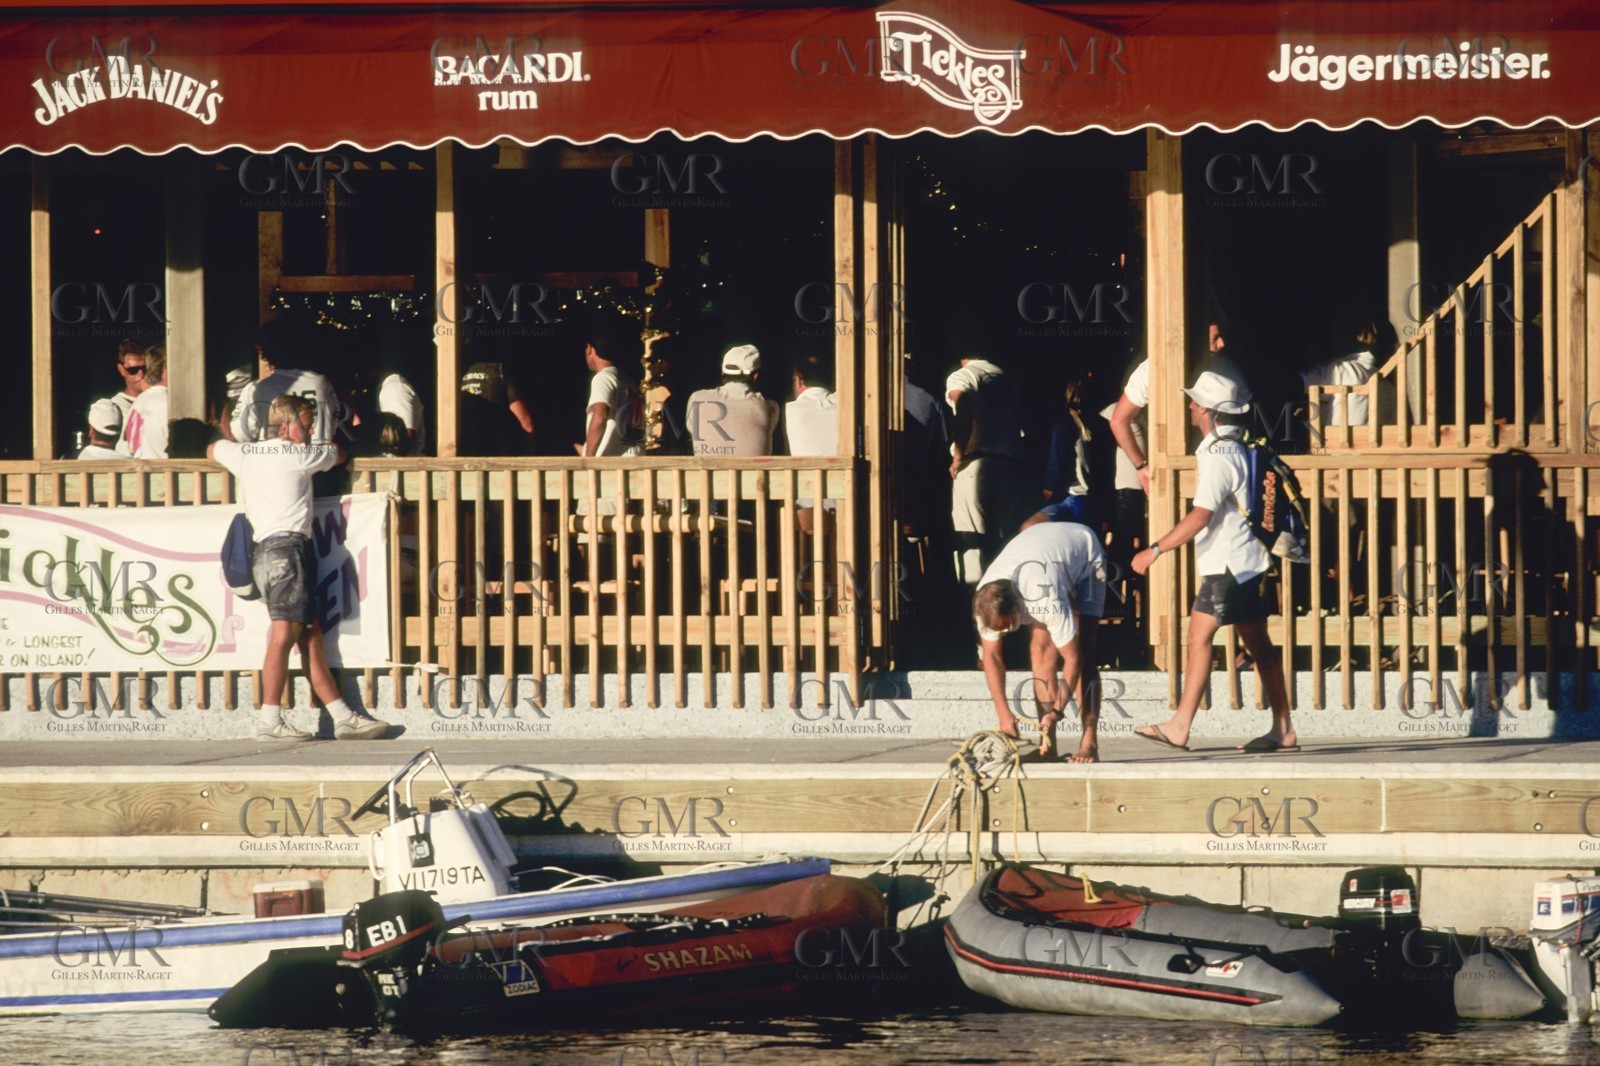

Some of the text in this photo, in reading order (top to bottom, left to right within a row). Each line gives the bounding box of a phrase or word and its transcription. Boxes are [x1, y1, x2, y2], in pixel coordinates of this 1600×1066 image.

[889, 31, 1012, 125] Tickles
[31, 55, 224, 125] JACK DANIEL'S
[478, 91, 538, 111] rum
[24, 635, 83, 648] LONGEST
[10, 654, 29, 666] ON
[36, 648, 96, 667] ISLAND!
[344, 928, 354, 950] 8
[643, 943, 753, 972] SHAZAM
[508, 982, 537, 994] ZODIAC
